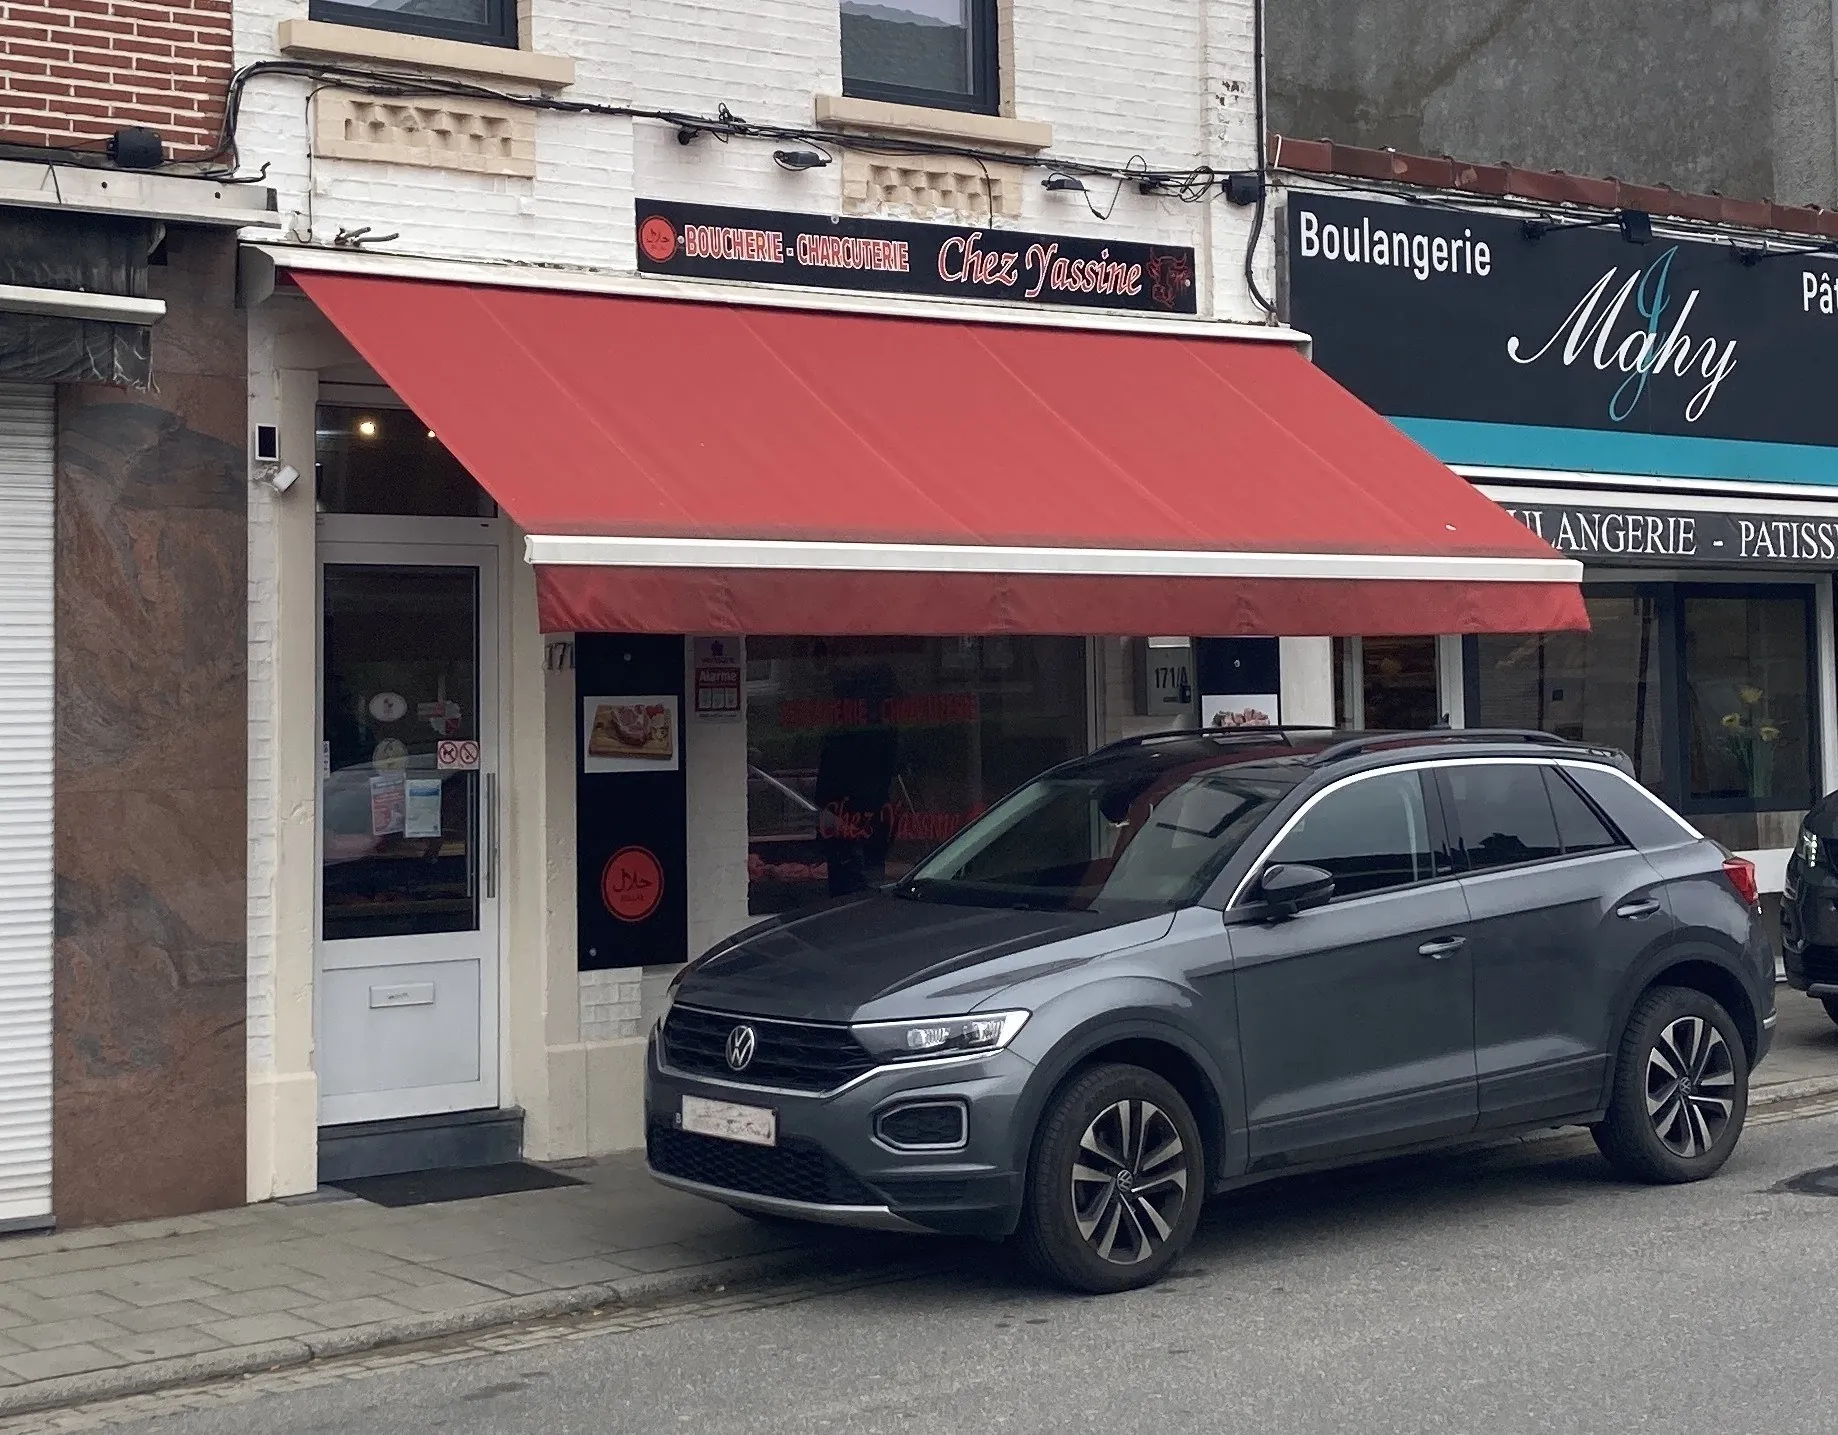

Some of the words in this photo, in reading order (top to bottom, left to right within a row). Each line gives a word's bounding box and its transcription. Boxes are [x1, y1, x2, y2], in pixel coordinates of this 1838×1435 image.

[684, 224, 783, 263] BOUCHERIE
[797, 233, 910, 272] CHARCUTERIE
[938, 232, 1018, 286] Chez
[1025, 243, 1143, 298] Yassine
[1300, 210, 1491, 280] Boulangerie
